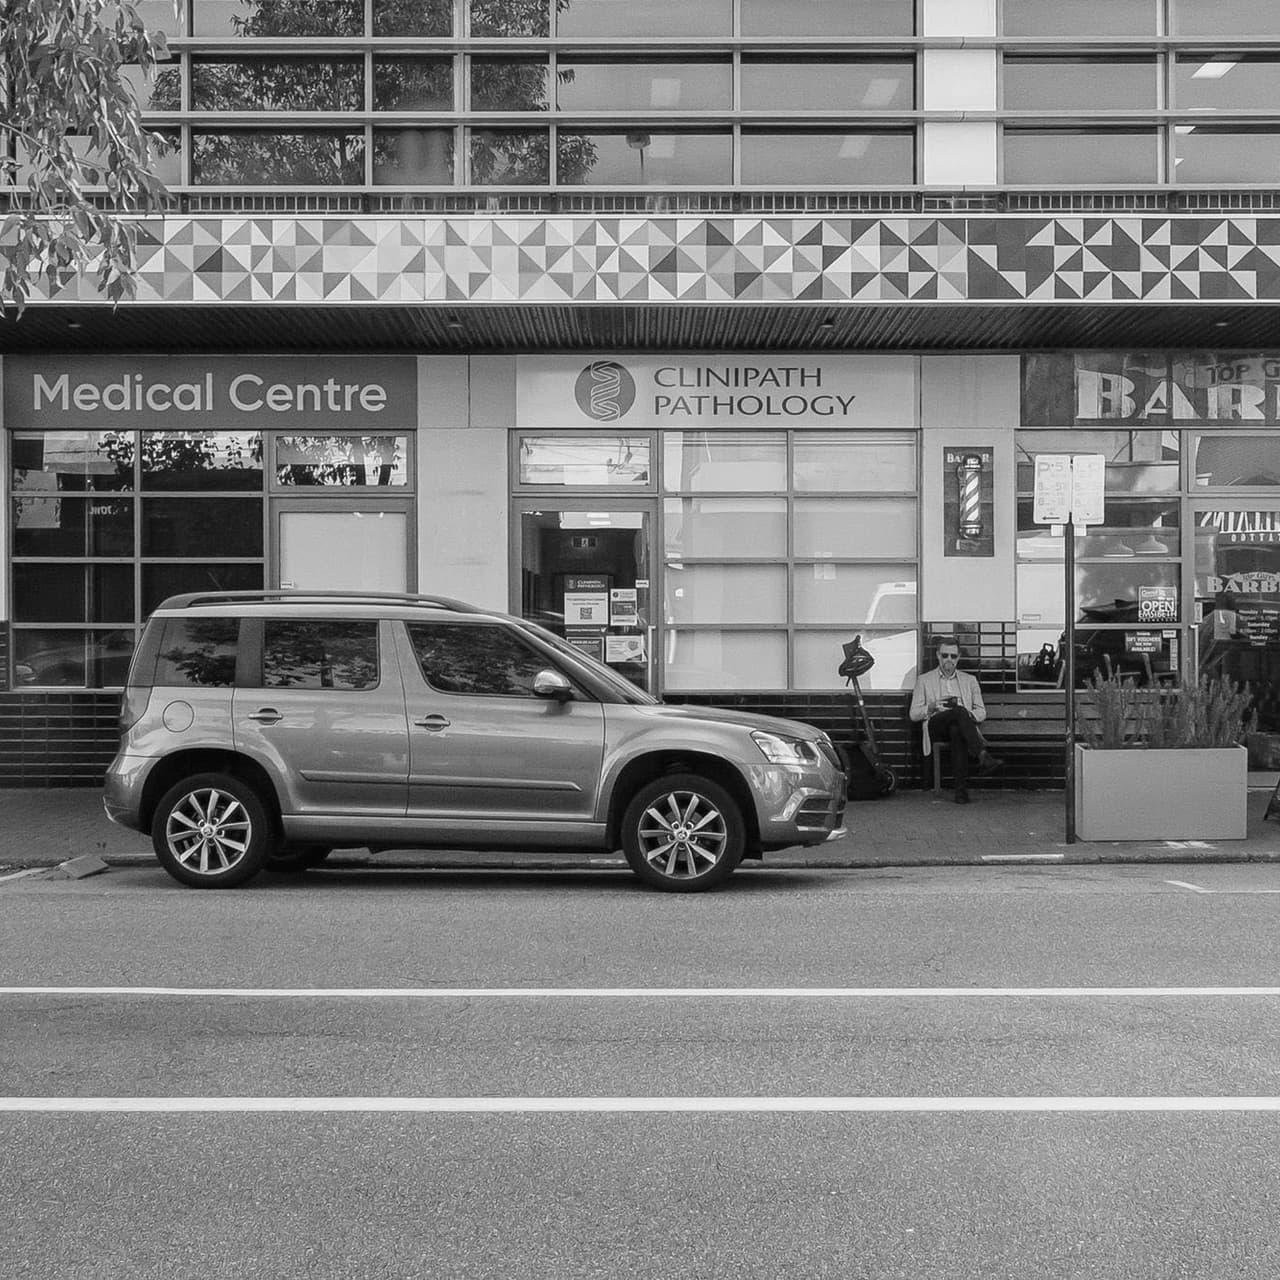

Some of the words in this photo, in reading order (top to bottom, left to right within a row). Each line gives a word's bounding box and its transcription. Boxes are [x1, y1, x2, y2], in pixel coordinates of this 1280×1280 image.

[654, 367, 822, 388] CLINIPATH
[1206, 363, 1250, 384] TOP
[33, 372, 214, 412] Medical
[228, 373, 388, 412] Centre
[654, 395, 856, 416] PATHOLOGY
[1142, 600, 1174, 612] OPEN
